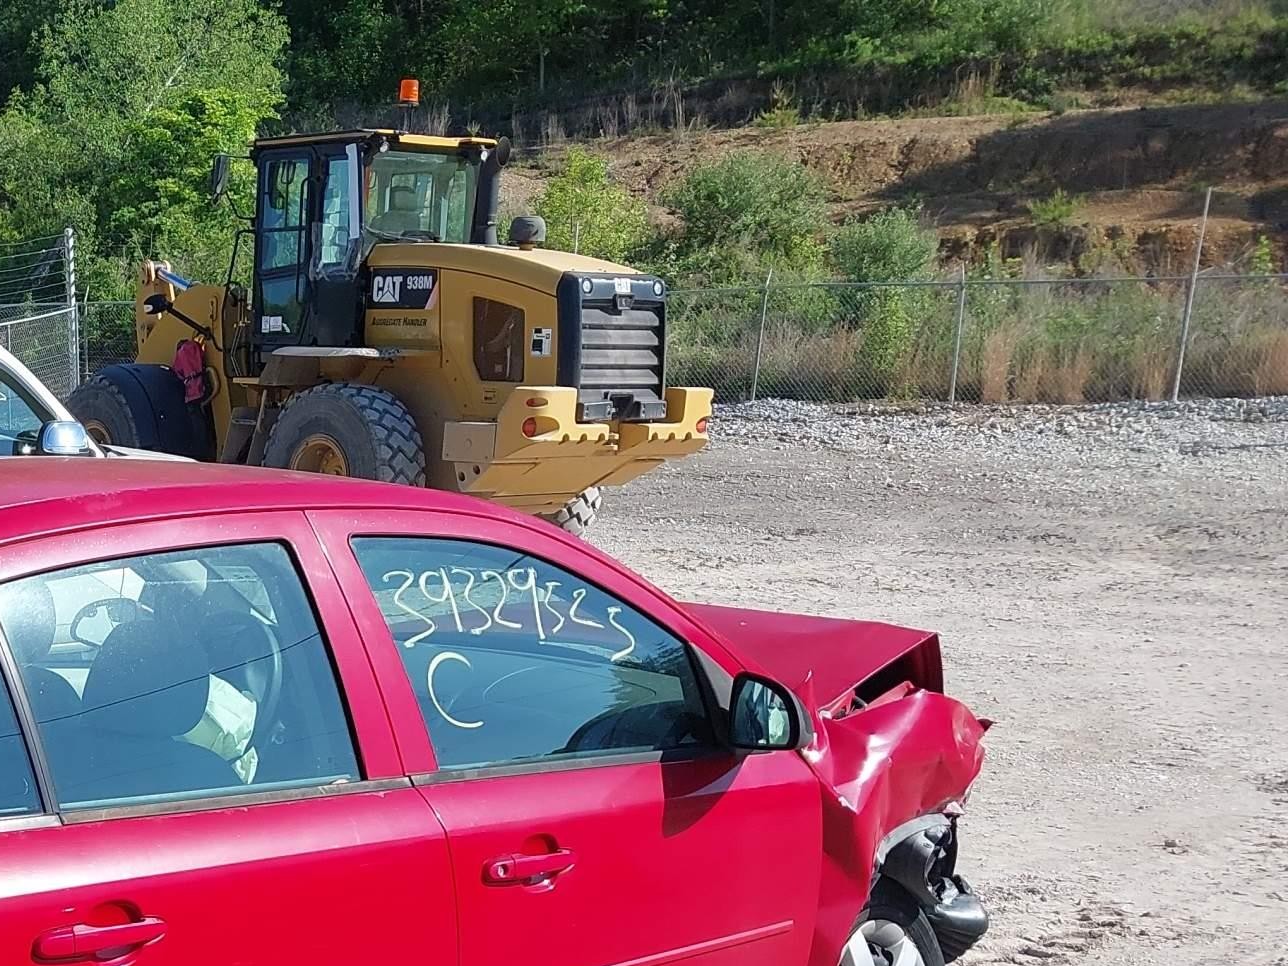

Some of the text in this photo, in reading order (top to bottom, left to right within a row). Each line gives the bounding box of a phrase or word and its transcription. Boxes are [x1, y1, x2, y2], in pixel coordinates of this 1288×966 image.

[373, 276, 432, 302] CAT 938M
[382, 565, 636, 662] 39329525
[427, 651, 485, 728] C
